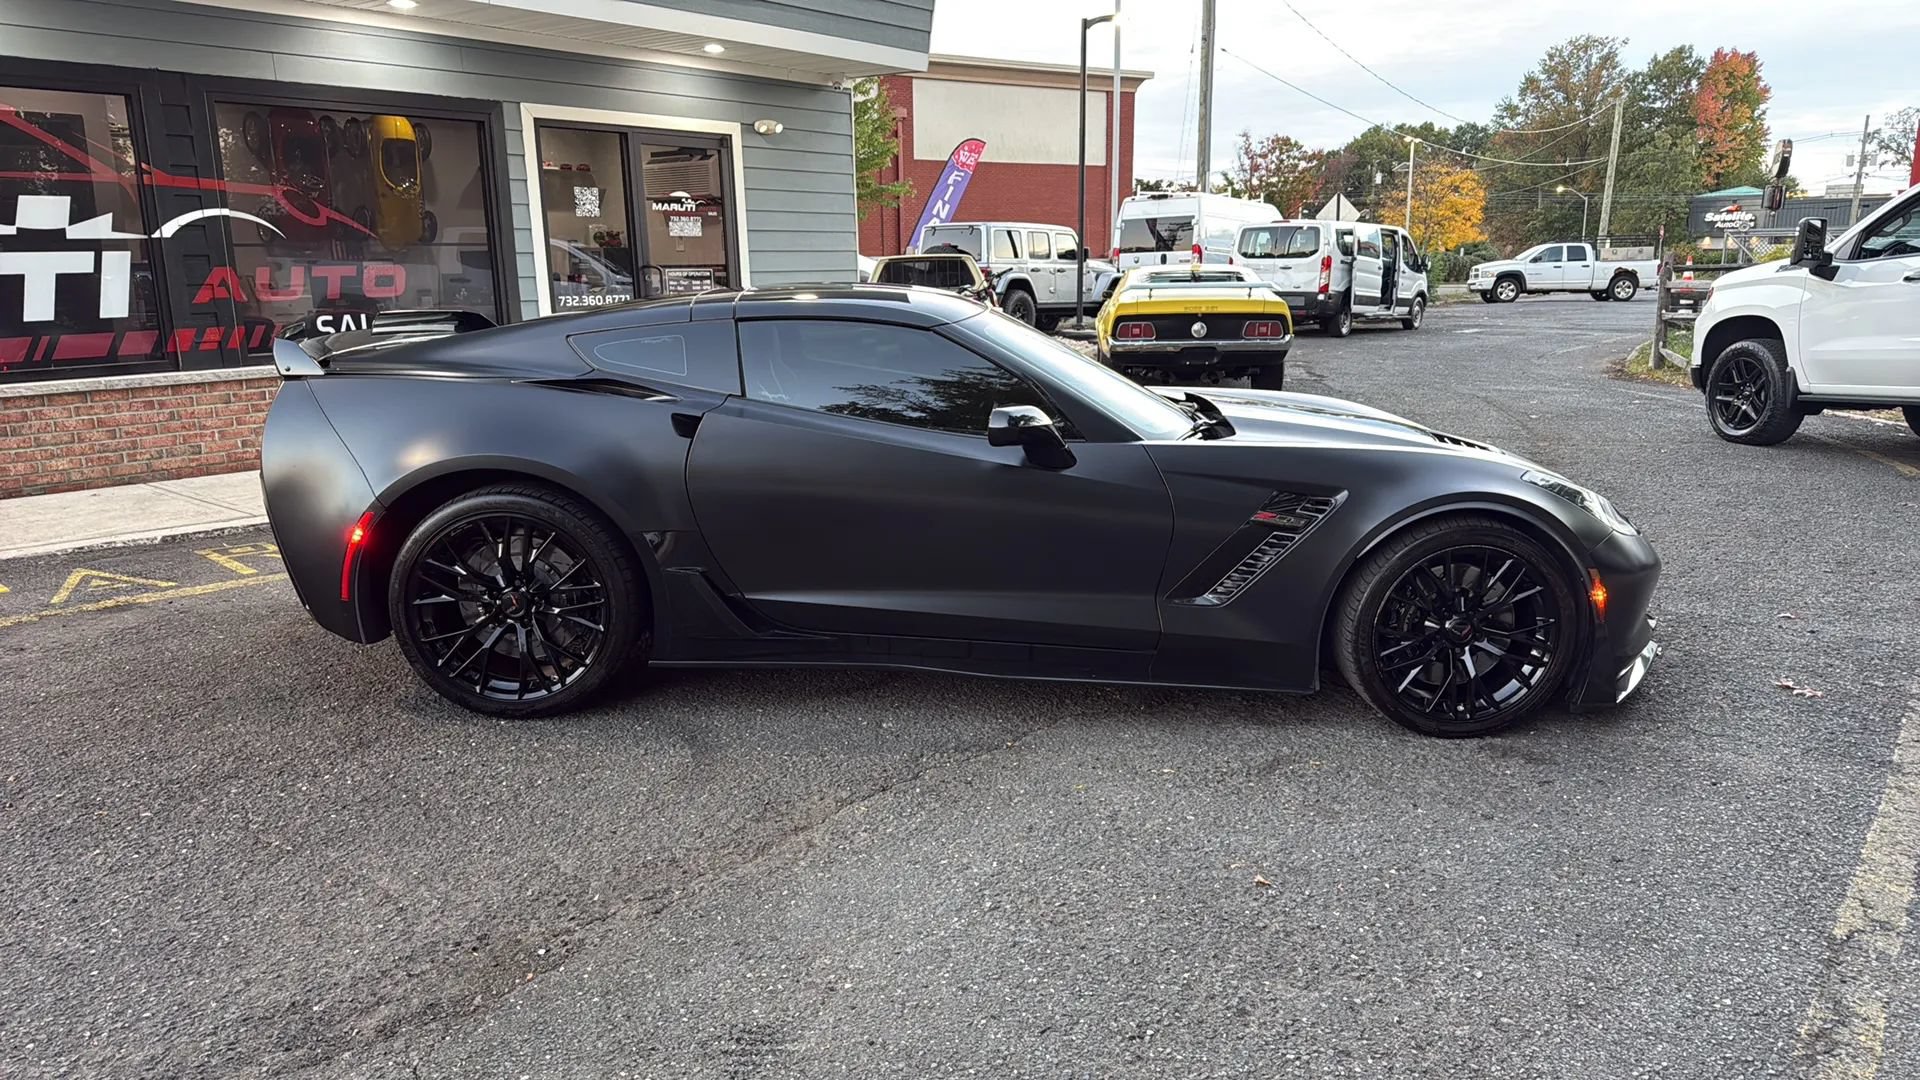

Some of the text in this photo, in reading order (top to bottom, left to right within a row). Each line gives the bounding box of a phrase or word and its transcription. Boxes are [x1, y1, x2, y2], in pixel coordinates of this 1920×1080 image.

[959, 149, 979, 166] WE
[652, 203, 696, 212] MARUTI
[1704, 211, 1753, 221] Safelite
[192, 264, 406, 304] AUTO
